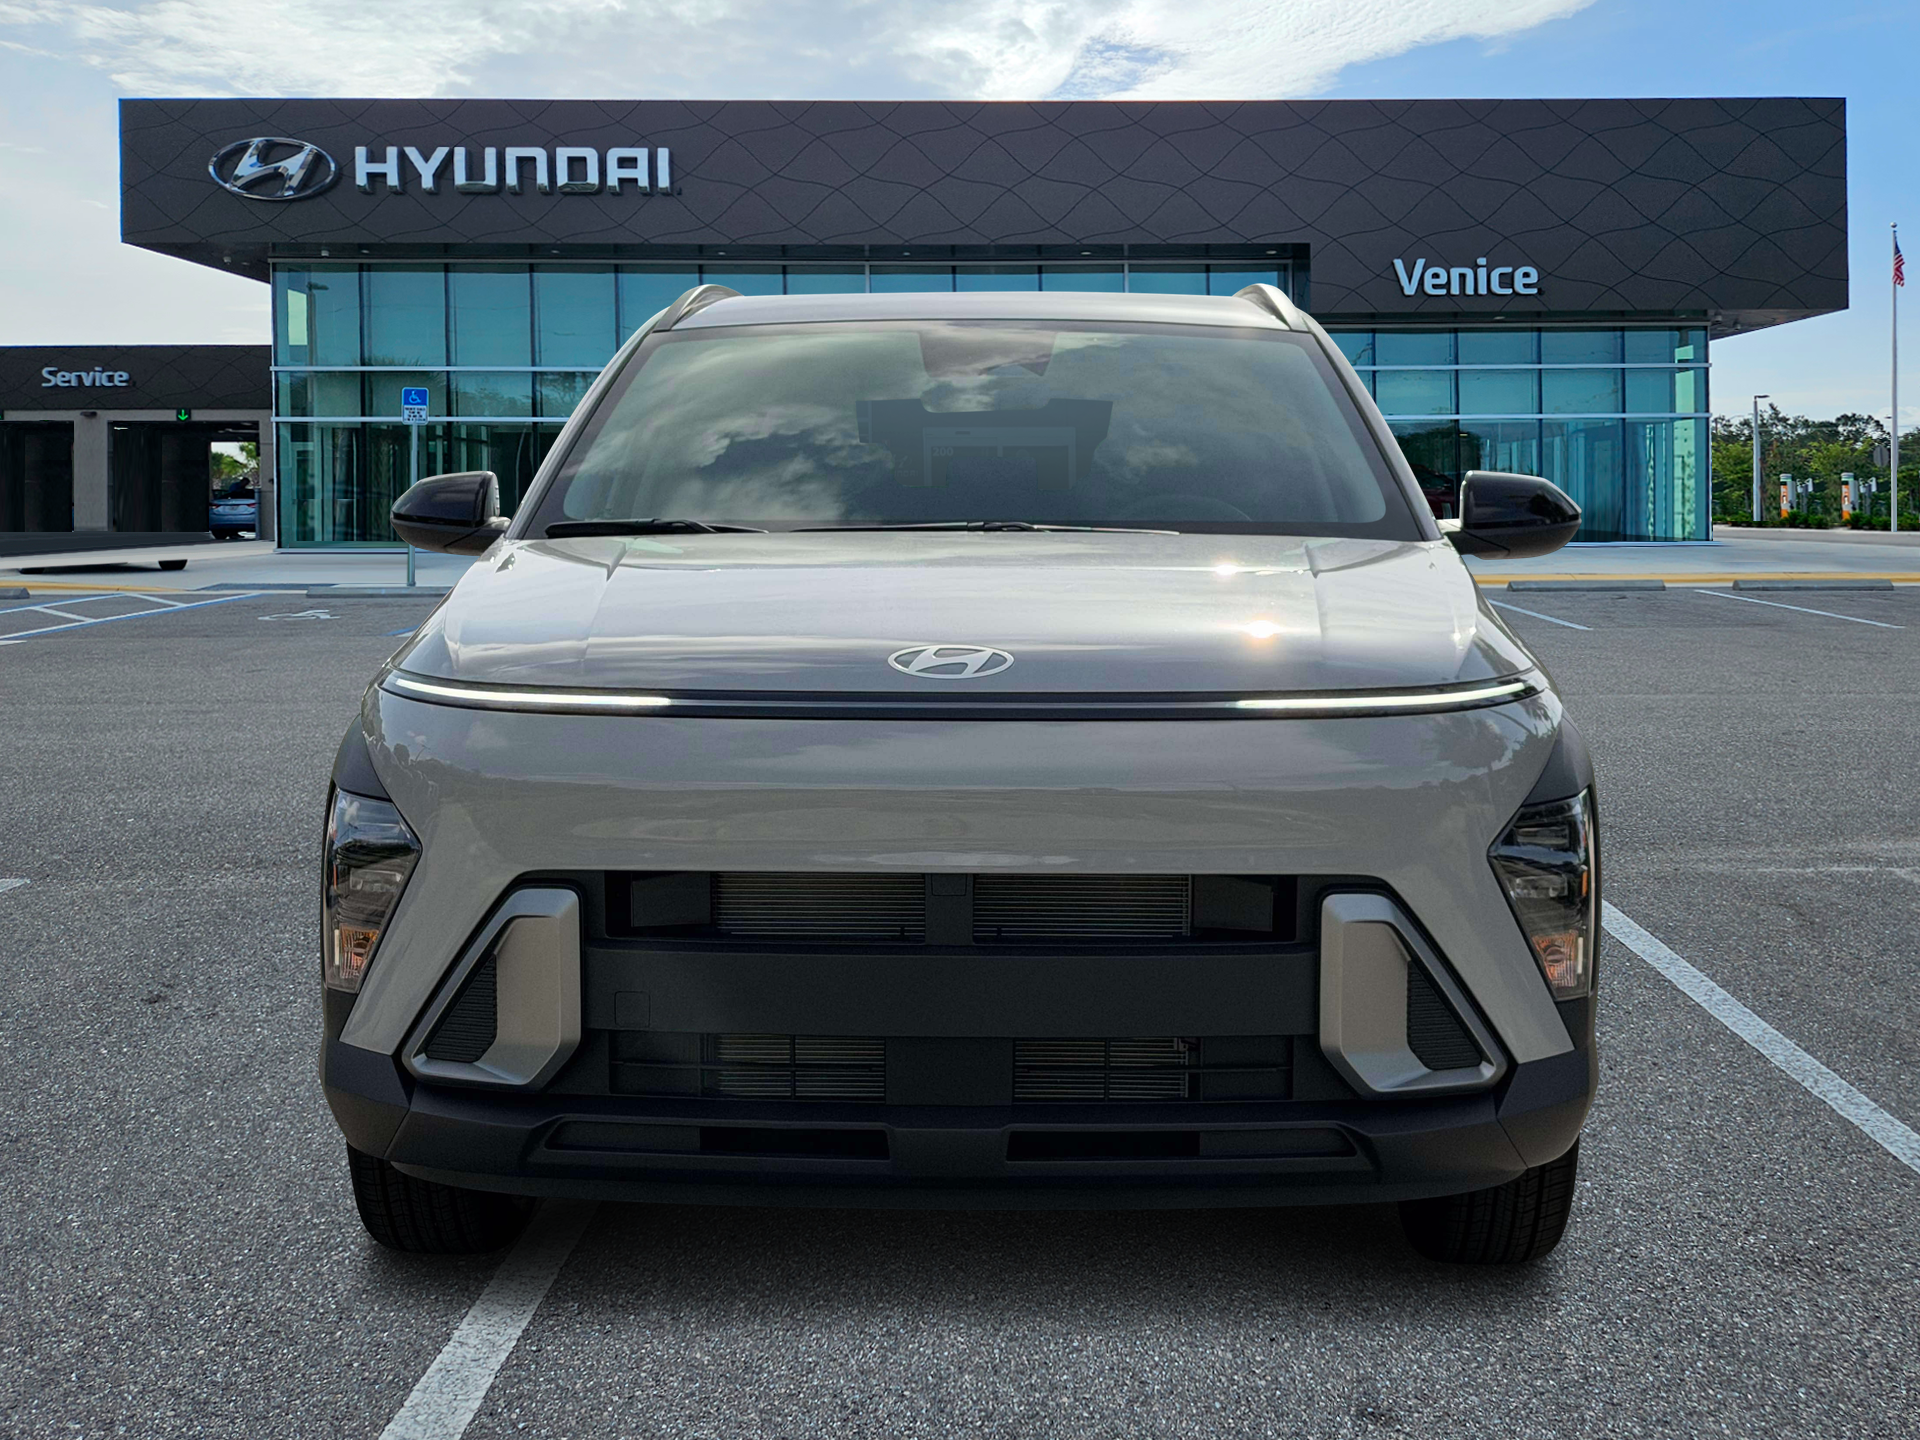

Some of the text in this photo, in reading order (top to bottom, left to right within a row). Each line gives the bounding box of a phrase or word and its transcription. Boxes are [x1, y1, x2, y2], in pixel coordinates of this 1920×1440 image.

[354, 146, 671, 193] HYUNDAI
[1393, 257, 1539, 296] Venice
[41, 366, 130, 387] Service
[932, 446, 954, 457] 200
